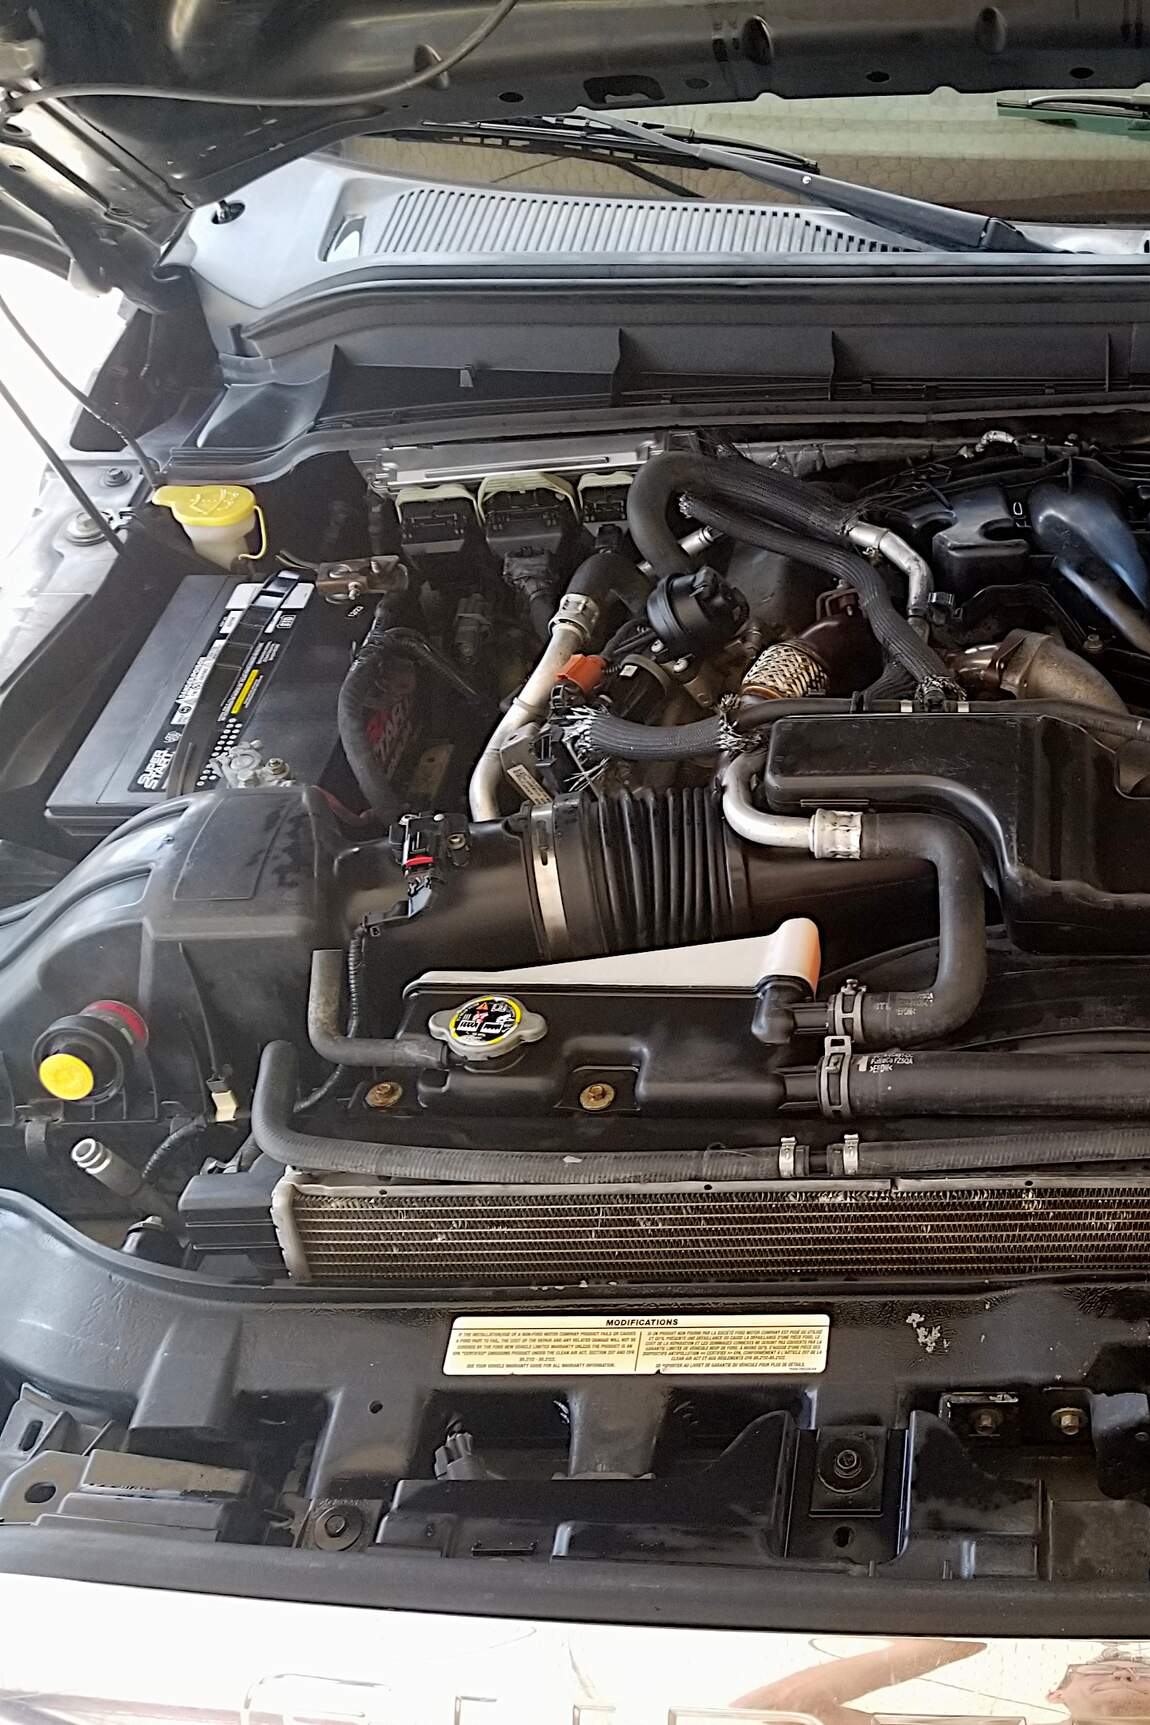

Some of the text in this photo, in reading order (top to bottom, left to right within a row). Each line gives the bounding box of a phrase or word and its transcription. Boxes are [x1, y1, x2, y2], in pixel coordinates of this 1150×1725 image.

[137, 750, 168, 784] SUPER
[144, 751, 174, 789] START
[605, 1318, 679, 1327] MODIFICATIONS
